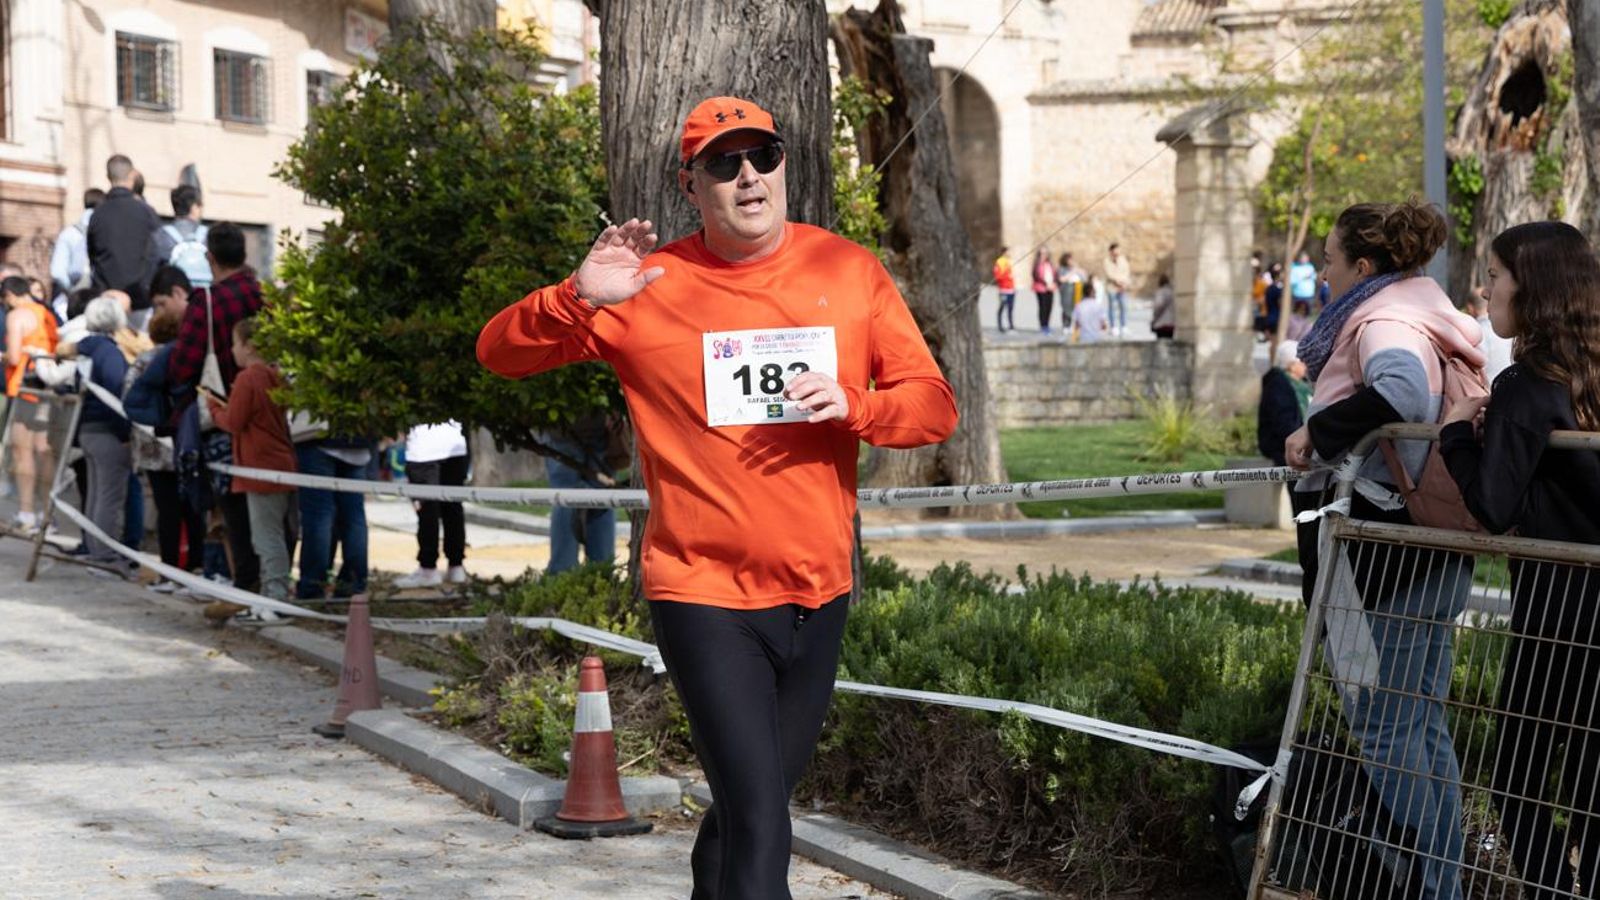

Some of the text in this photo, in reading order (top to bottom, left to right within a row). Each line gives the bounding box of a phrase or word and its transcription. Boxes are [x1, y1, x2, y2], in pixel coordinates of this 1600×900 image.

[1136, 475, 1181, 486] DEPORTES
[1213, 470, 1267, 484] Ayuntamiento
[1269, 469, 1280, 481] de
[975, 485, 1014, 495] DEPORTES
